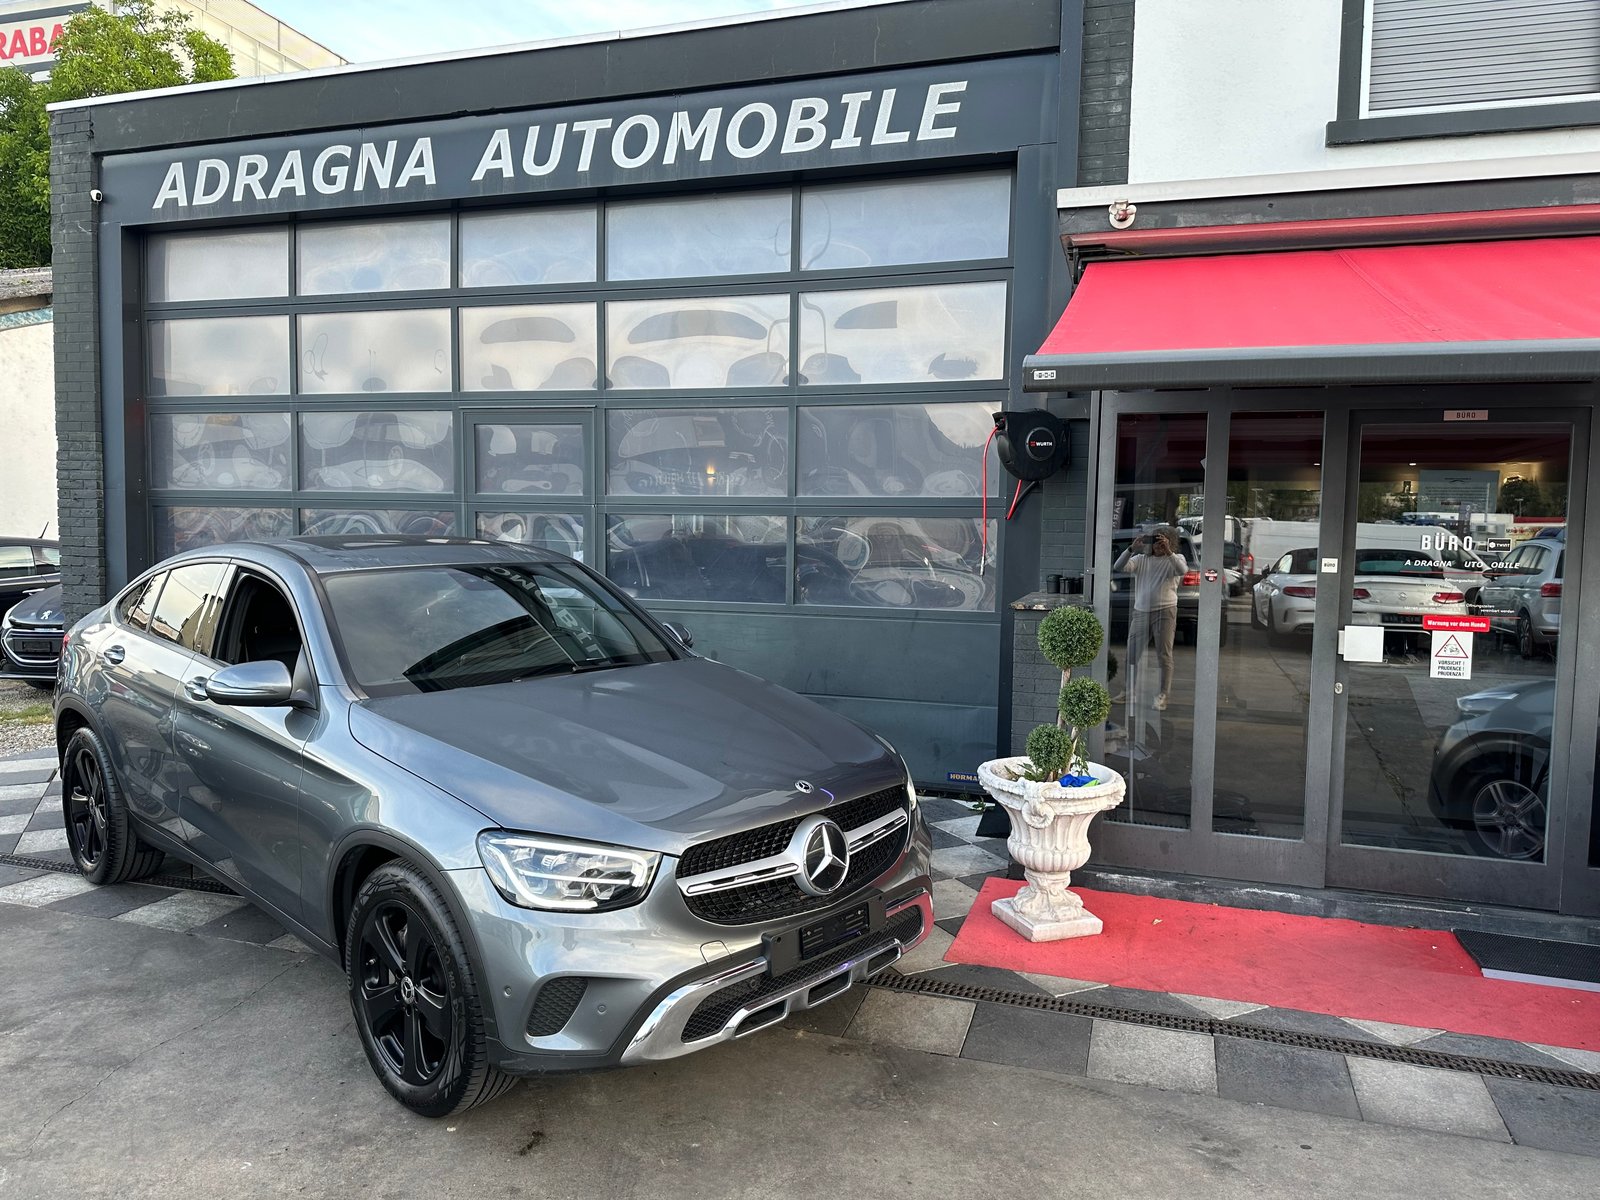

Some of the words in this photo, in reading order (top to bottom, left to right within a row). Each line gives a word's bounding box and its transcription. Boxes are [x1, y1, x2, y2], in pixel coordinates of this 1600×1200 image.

[152, 137, 437, 209] ADRAGNA
[471, 80, 969, 181] AUTOMOBILE
[1421, 533, 1473, 551] BÜRO
[1427, 619, 1450, 628] Warnung
